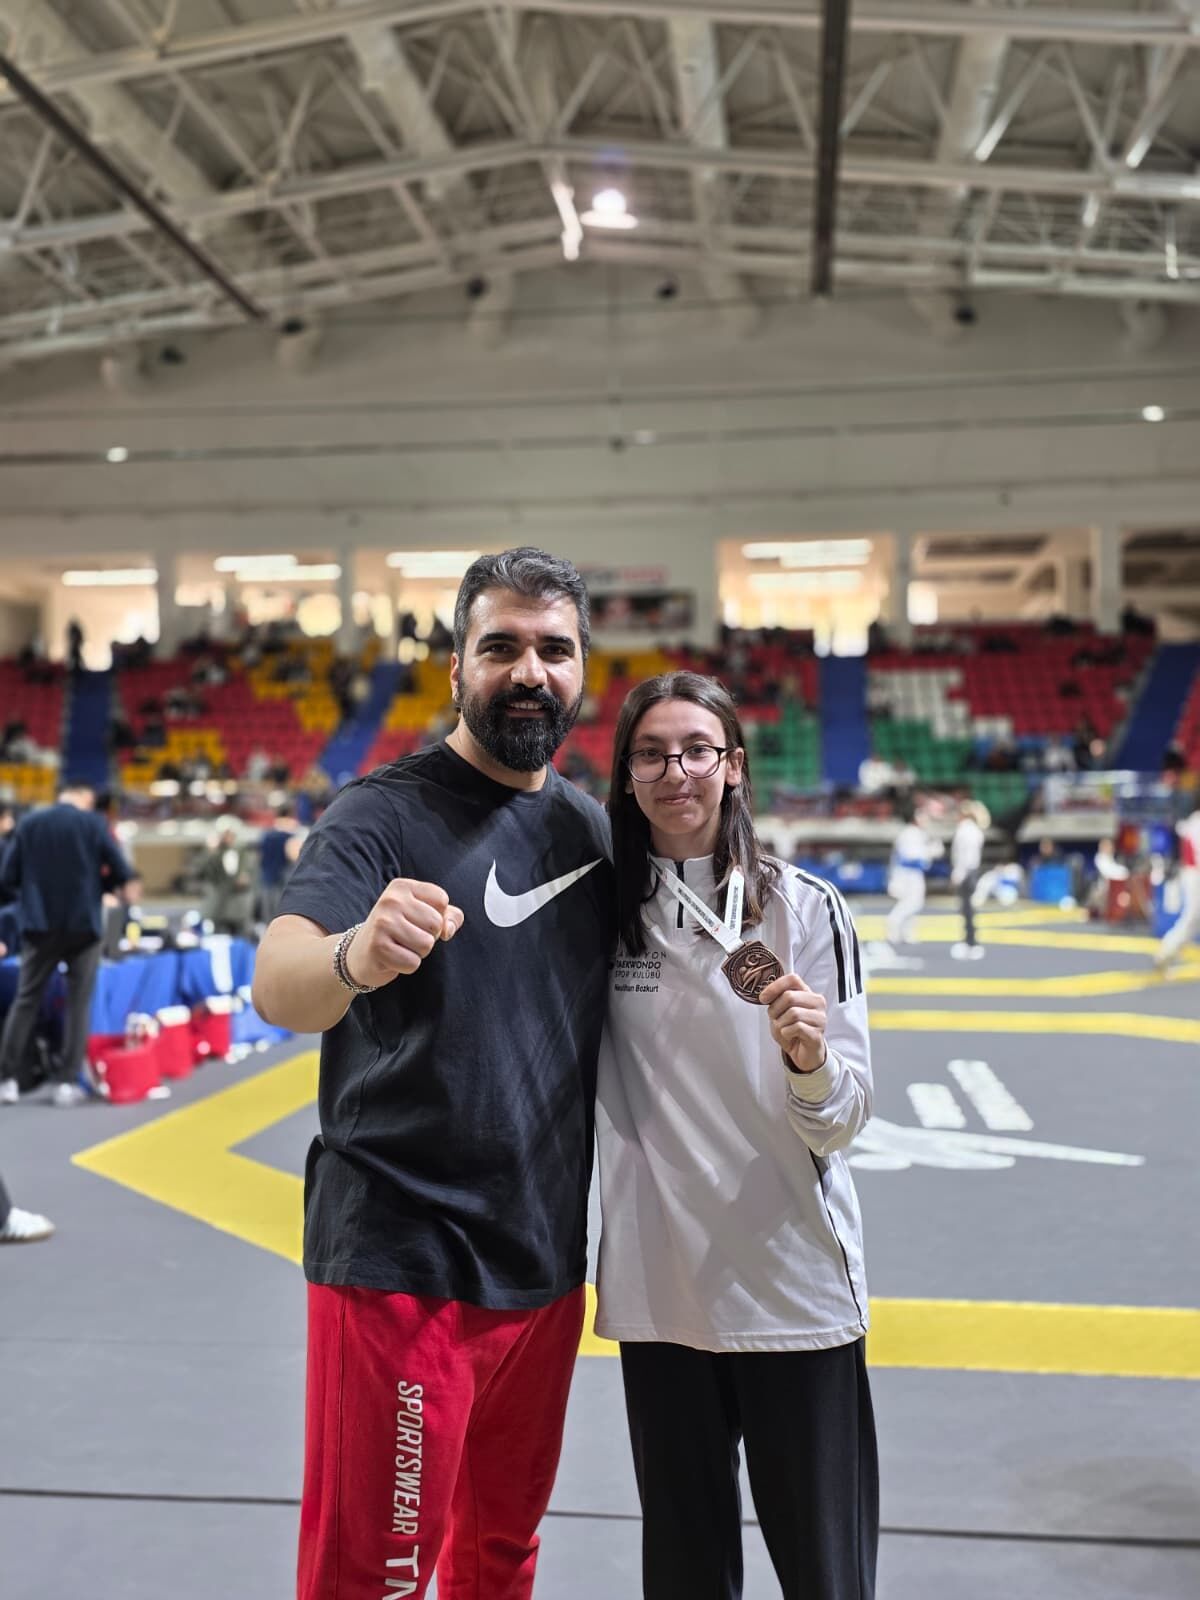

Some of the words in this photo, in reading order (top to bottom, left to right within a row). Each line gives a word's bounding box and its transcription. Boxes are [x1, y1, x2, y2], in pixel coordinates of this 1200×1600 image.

[616, 960, 662, 969] TAEKWONDO
[615, 970, 630, 979] SPOR
[632, 969, 661, 980] KULÜBÜ
[635, 984, 659, 993] Bozkurt
[392, 1380, 424, 1536] SPORTSWEAR
